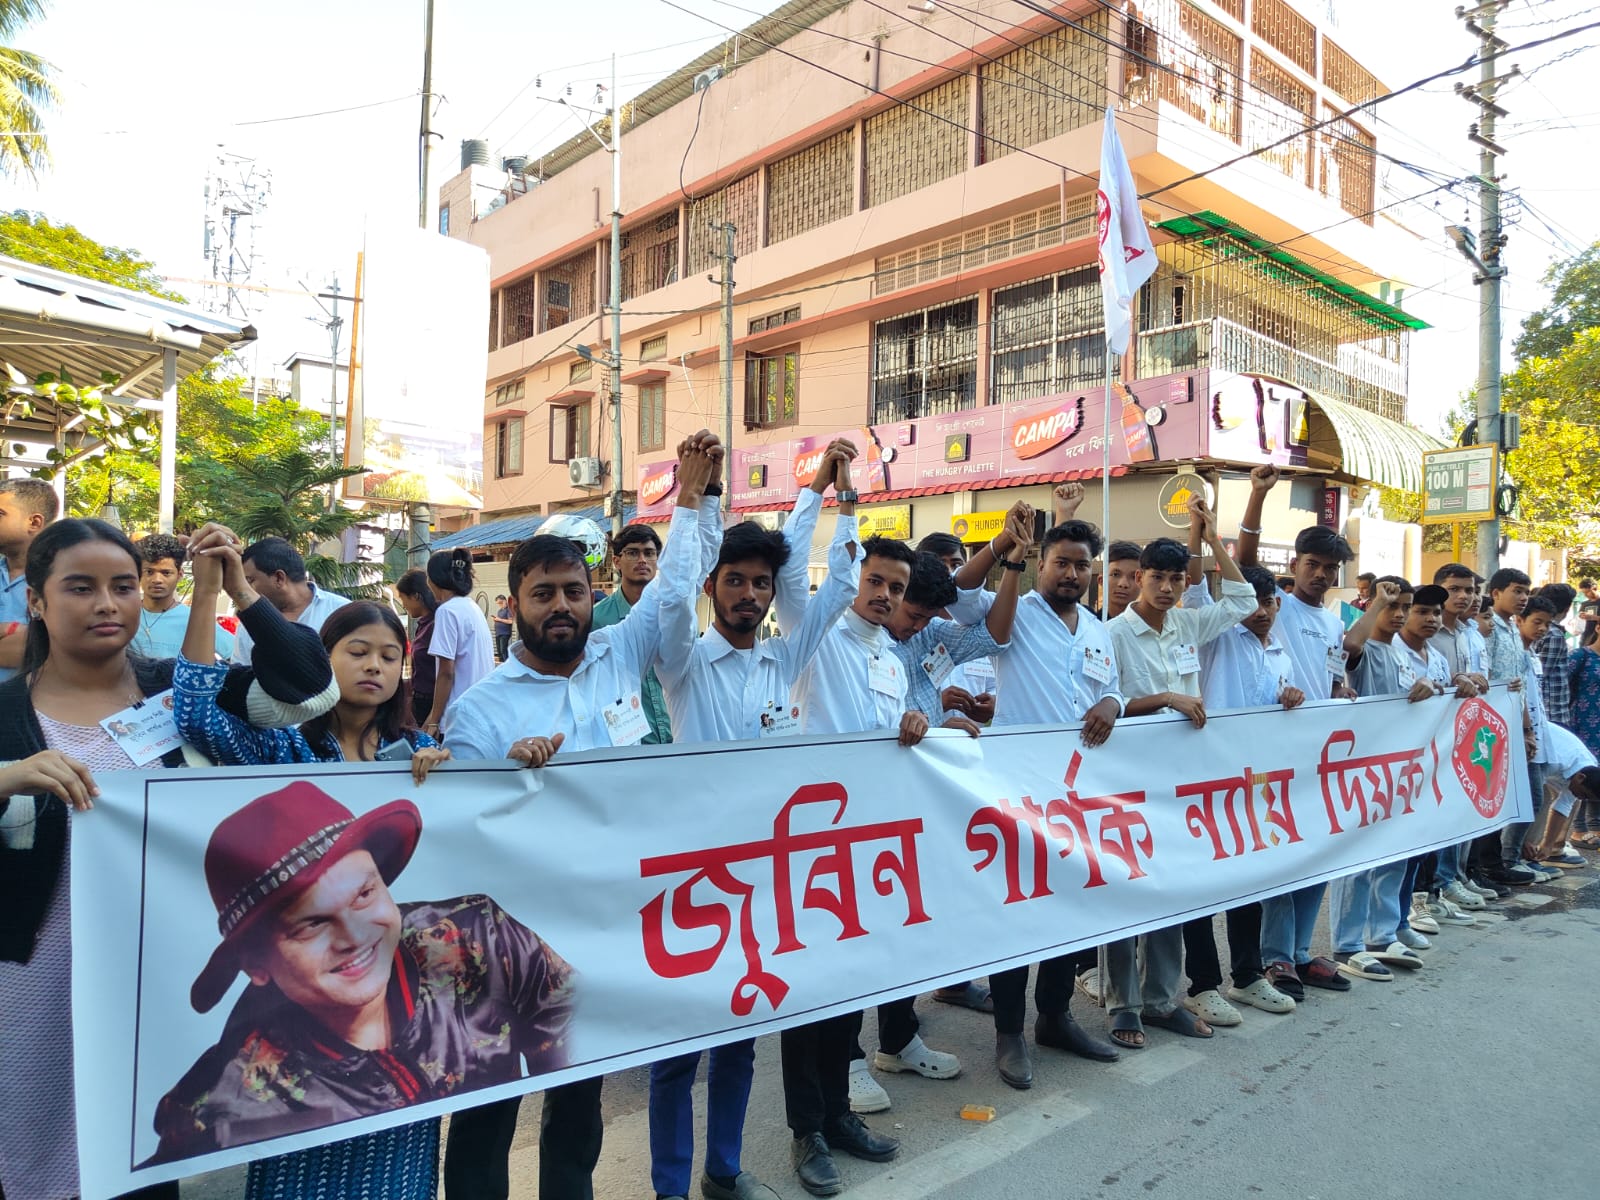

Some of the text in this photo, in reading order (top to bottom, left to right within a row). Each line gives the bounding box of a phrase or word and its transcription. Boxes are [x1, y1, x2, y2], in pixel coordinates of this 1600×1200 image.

[1014, 407, 1076, 447] CAMPA
[796, 452, 825, 477] CAM
[922, 468, 934, 478] THE
[935, 465, 962, 477] HUNGRY
[963, 462, 995, 474] PALETTE
[642, 471, 674, 497] CAMPA
[1426, 470, 1449, 490] 100
[1453, 469, 1464, 488] M
[875, 516, 897, 528] HUNGRY
[974, 518, 1005, 531] HUNGRY
